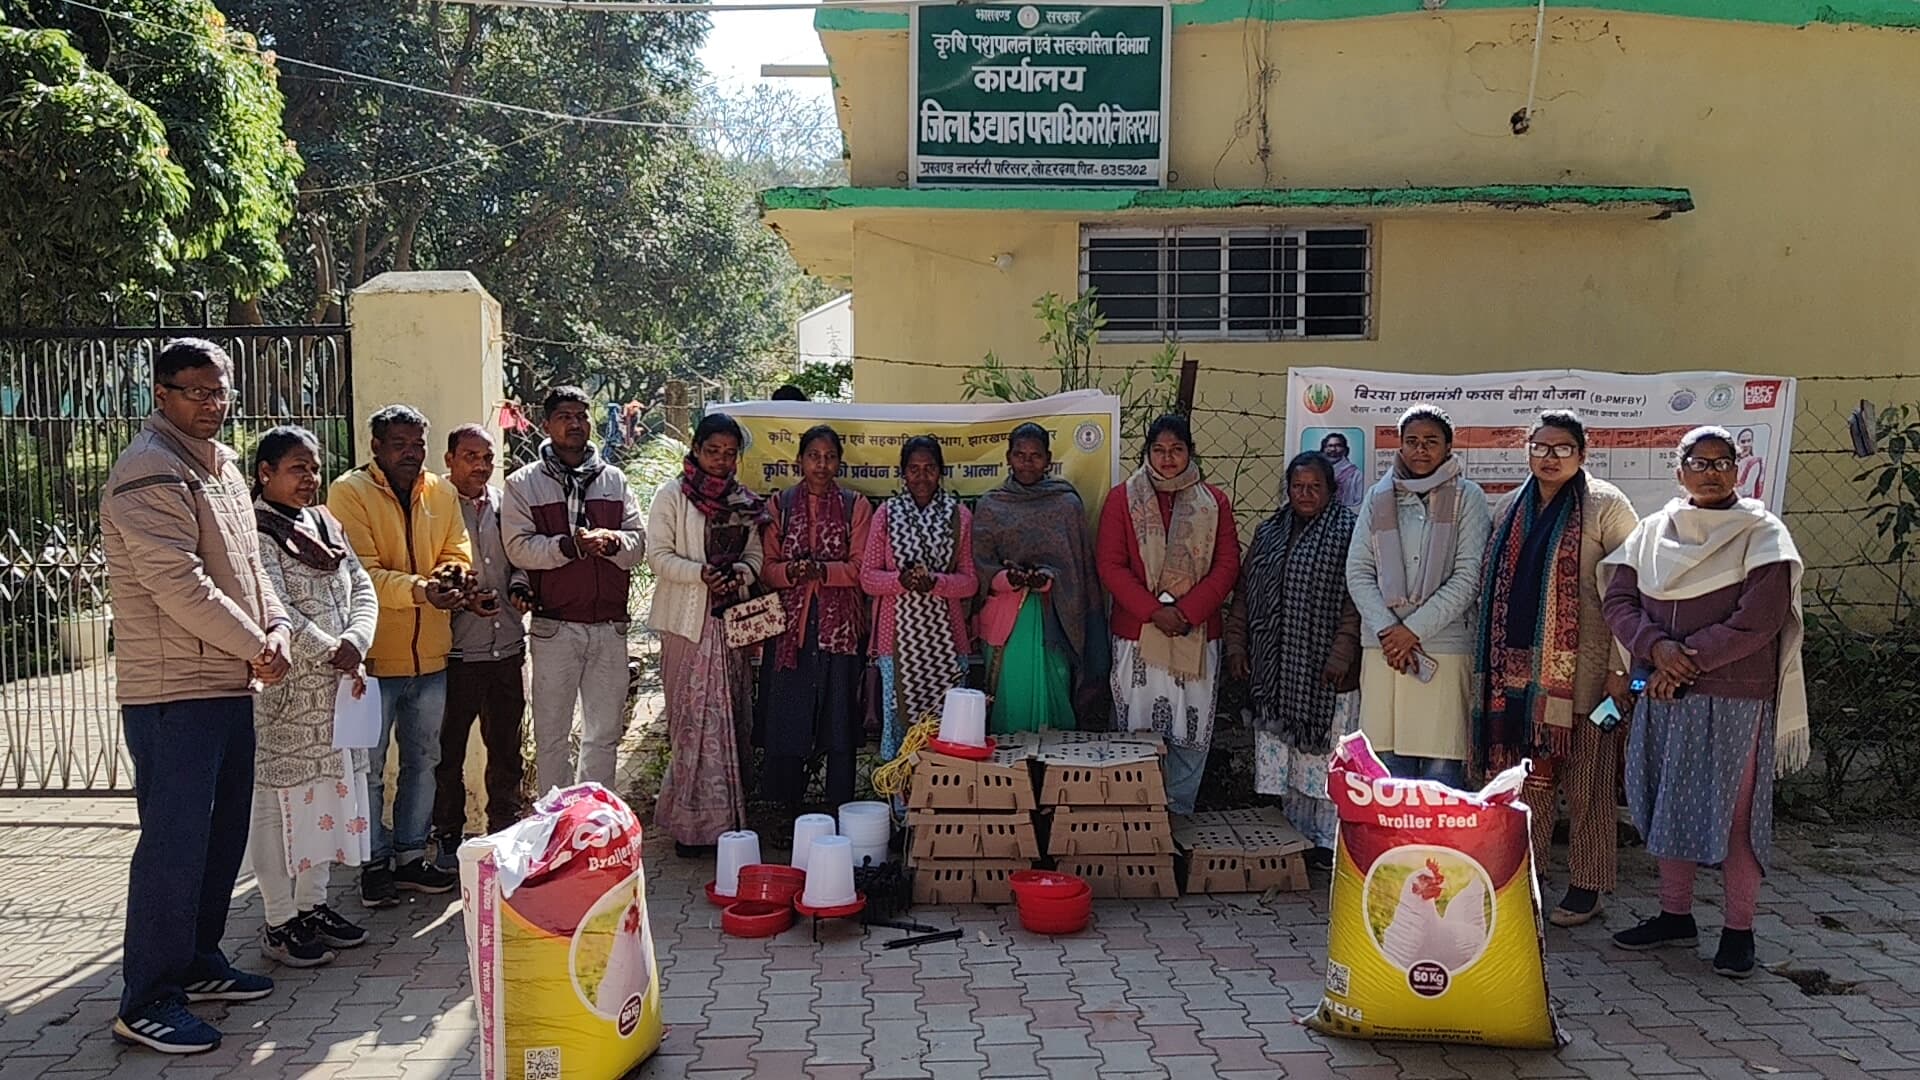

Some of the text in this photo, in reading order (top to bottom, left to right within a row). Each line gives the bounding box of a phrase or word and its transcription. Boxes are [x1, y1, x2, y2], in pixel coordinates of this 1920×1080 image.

[1045, 11, 1082, 24] सरकार
[932, 29, 1150, 59] कृषि पशुपालन एवं सहकारिता विभाग
[971, 56, 1087, 92] कार्यालय
[920, 98, 971, 144] जिला
[1101, 164, 1147, 176] 835302
[1354, 384, 1396, 402] बिरसा
[1399, 387, 1463, 402] प्रधानमंत्री
[1466, 388, 1504, 402] फसल
[1542, 385, 1587, 401] योजना
[1590, 391, 1648, 406] (B-PMFBY)
[1746, 385, 1775, 396] HDFC
[850, 432, 865, 447] एवं
[763, 460, 788, 482] कृषि
[957, 462, 1003, 478] 'आत्मा'
[1378, 813, 1478, 829] Broiler Feed
[588, 844, 632, 872] Broiler
[1413, 970, 1444, 986] 50 Kg
